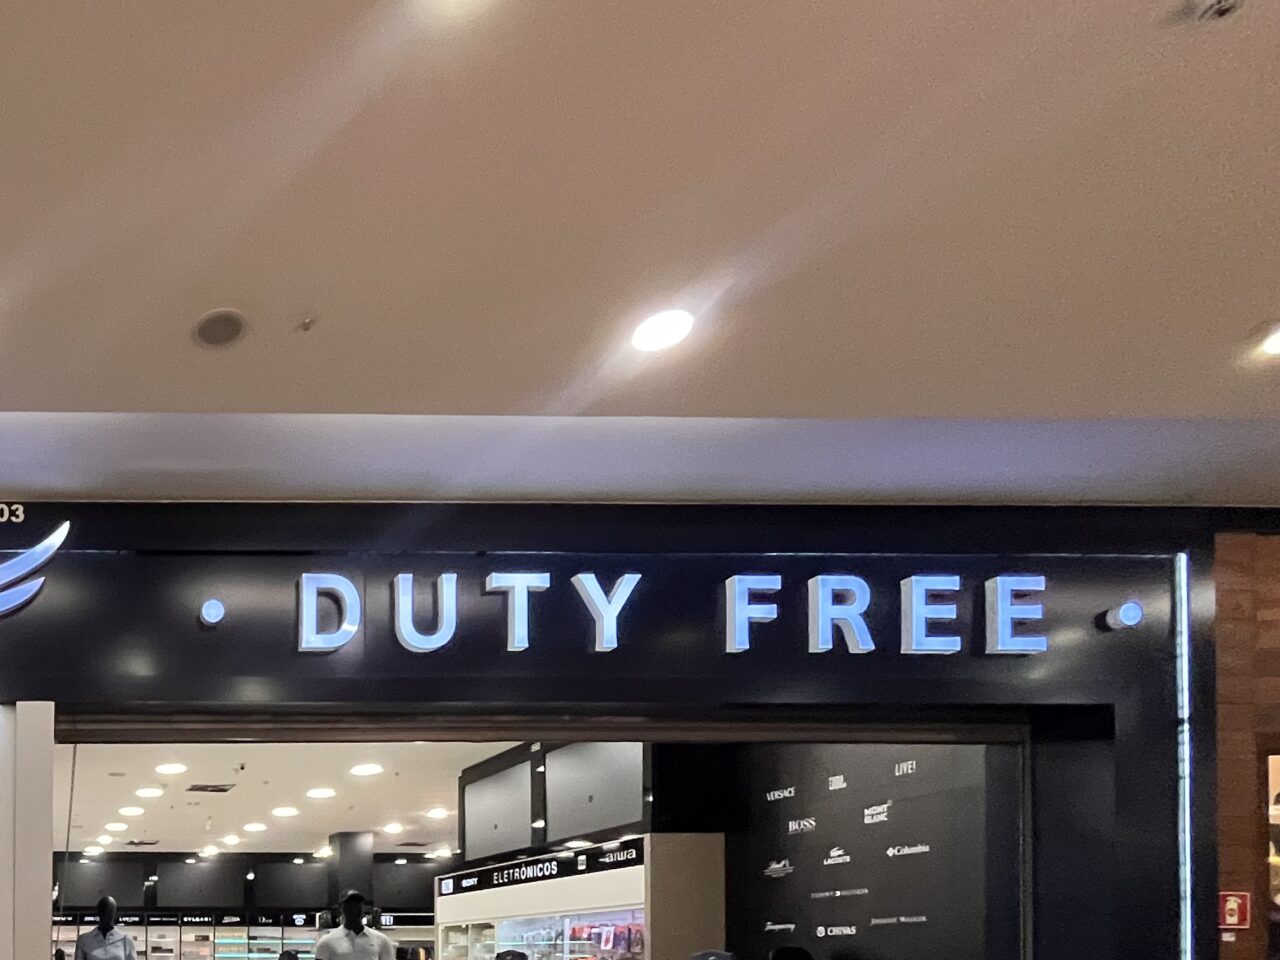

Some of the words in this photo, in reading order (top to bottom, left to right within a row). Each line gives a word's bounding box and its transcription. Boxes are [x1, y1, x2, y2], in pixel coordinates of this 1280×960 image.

[298, 572, 642, 653] DUTY
[724, 574, 1048, 656] FREE
[788, 817, 817, 832] BOSS
